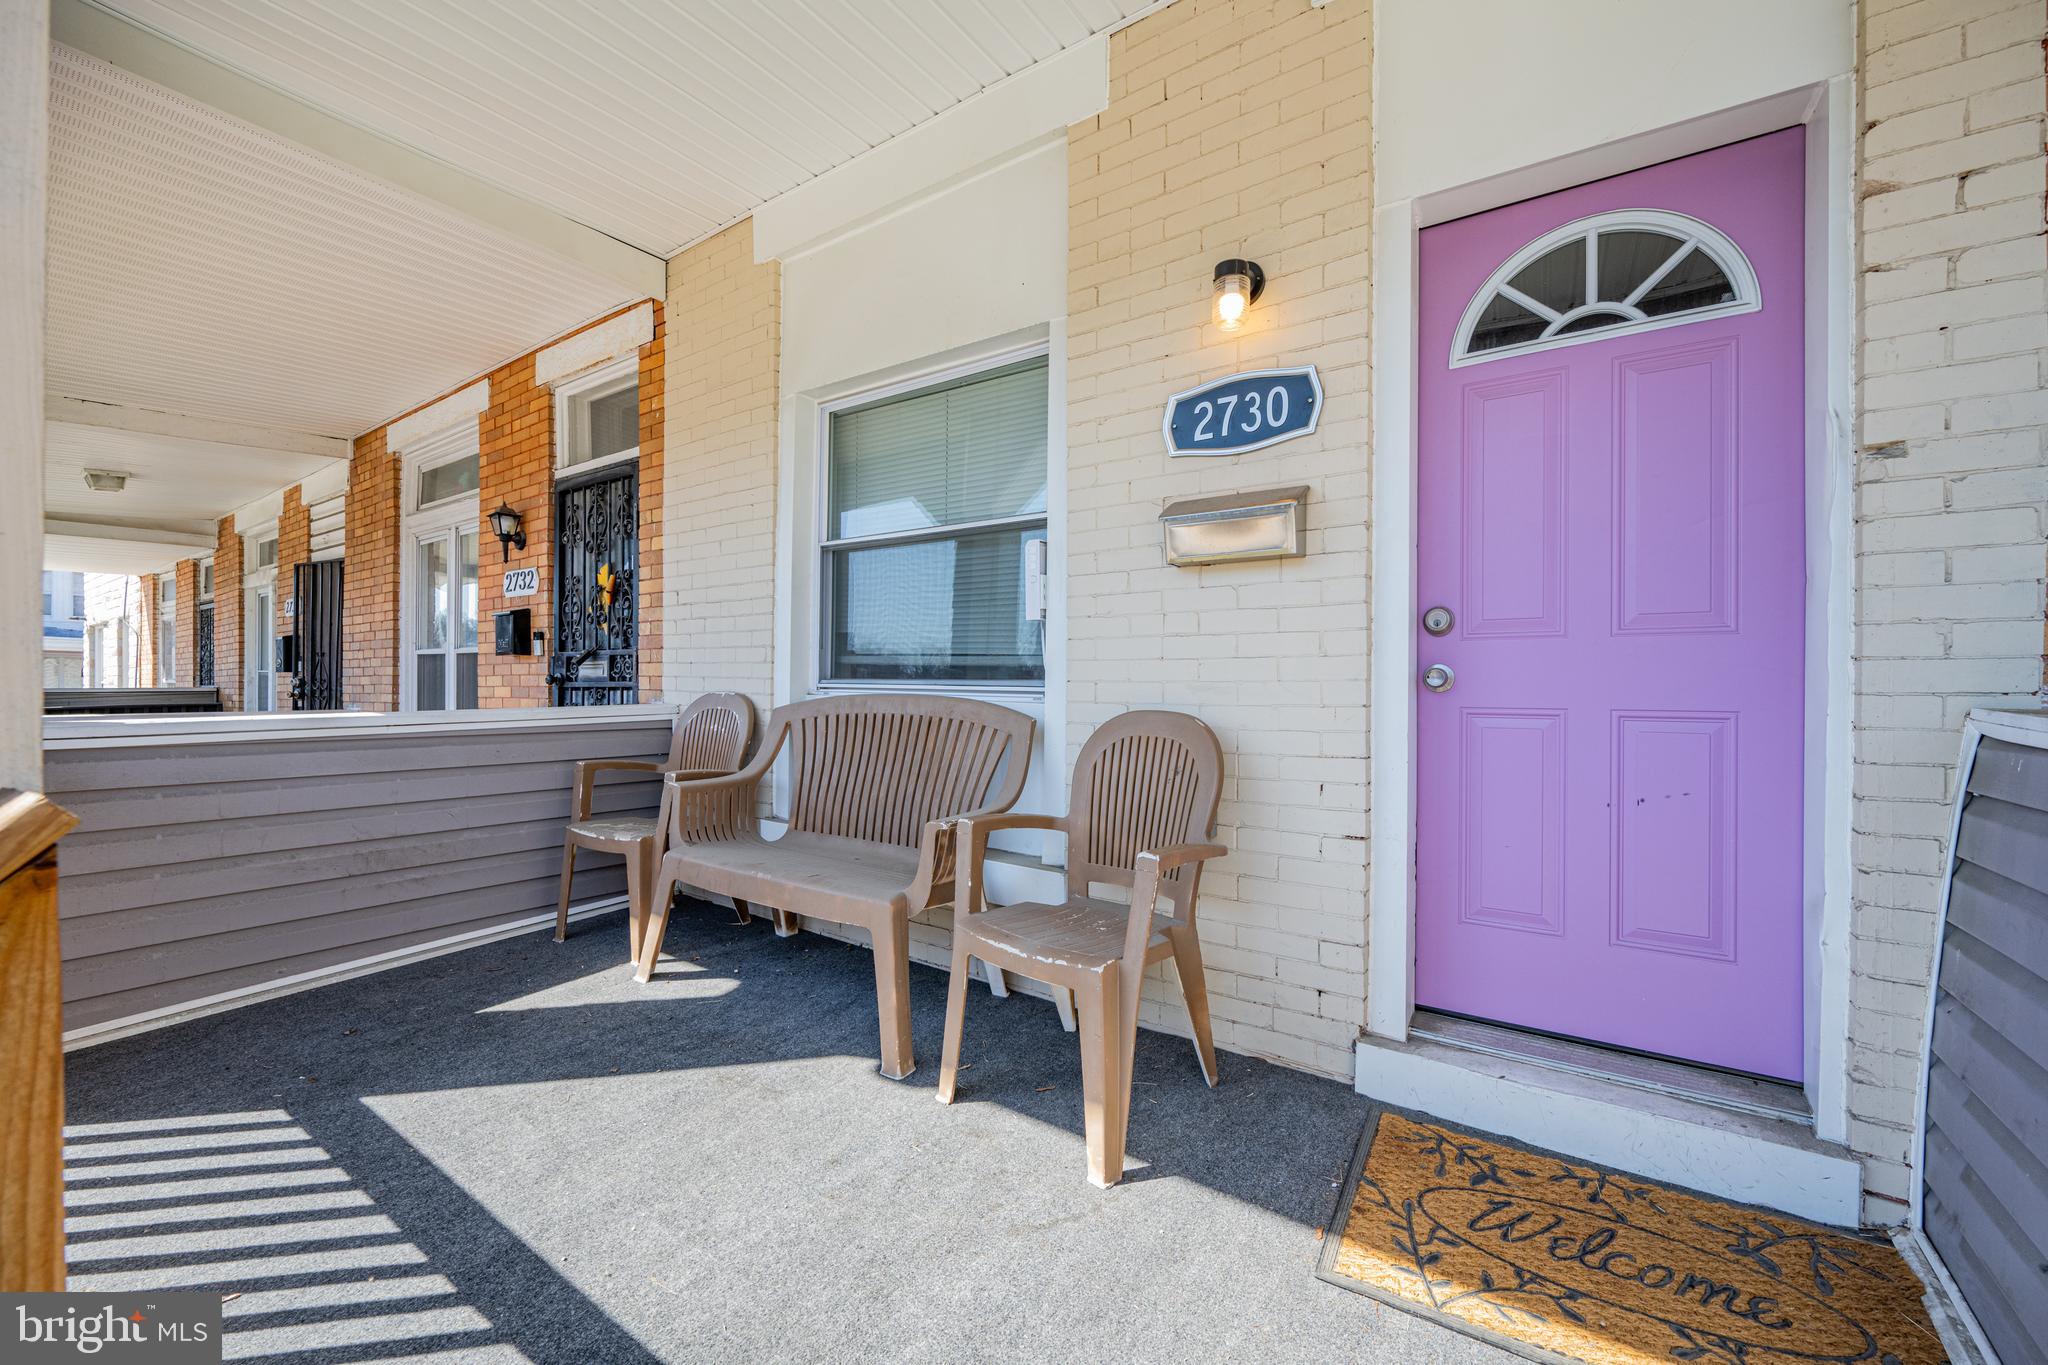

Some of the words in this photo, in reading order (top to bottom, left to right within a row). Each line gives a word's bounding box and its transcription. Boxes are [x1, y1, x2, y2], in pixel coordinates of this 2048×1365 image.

[1193, 386, 1289, 442] 2730
[505, 570, 535, 593] 2732
[1467, 1199, 1793, 1329] Welcome
